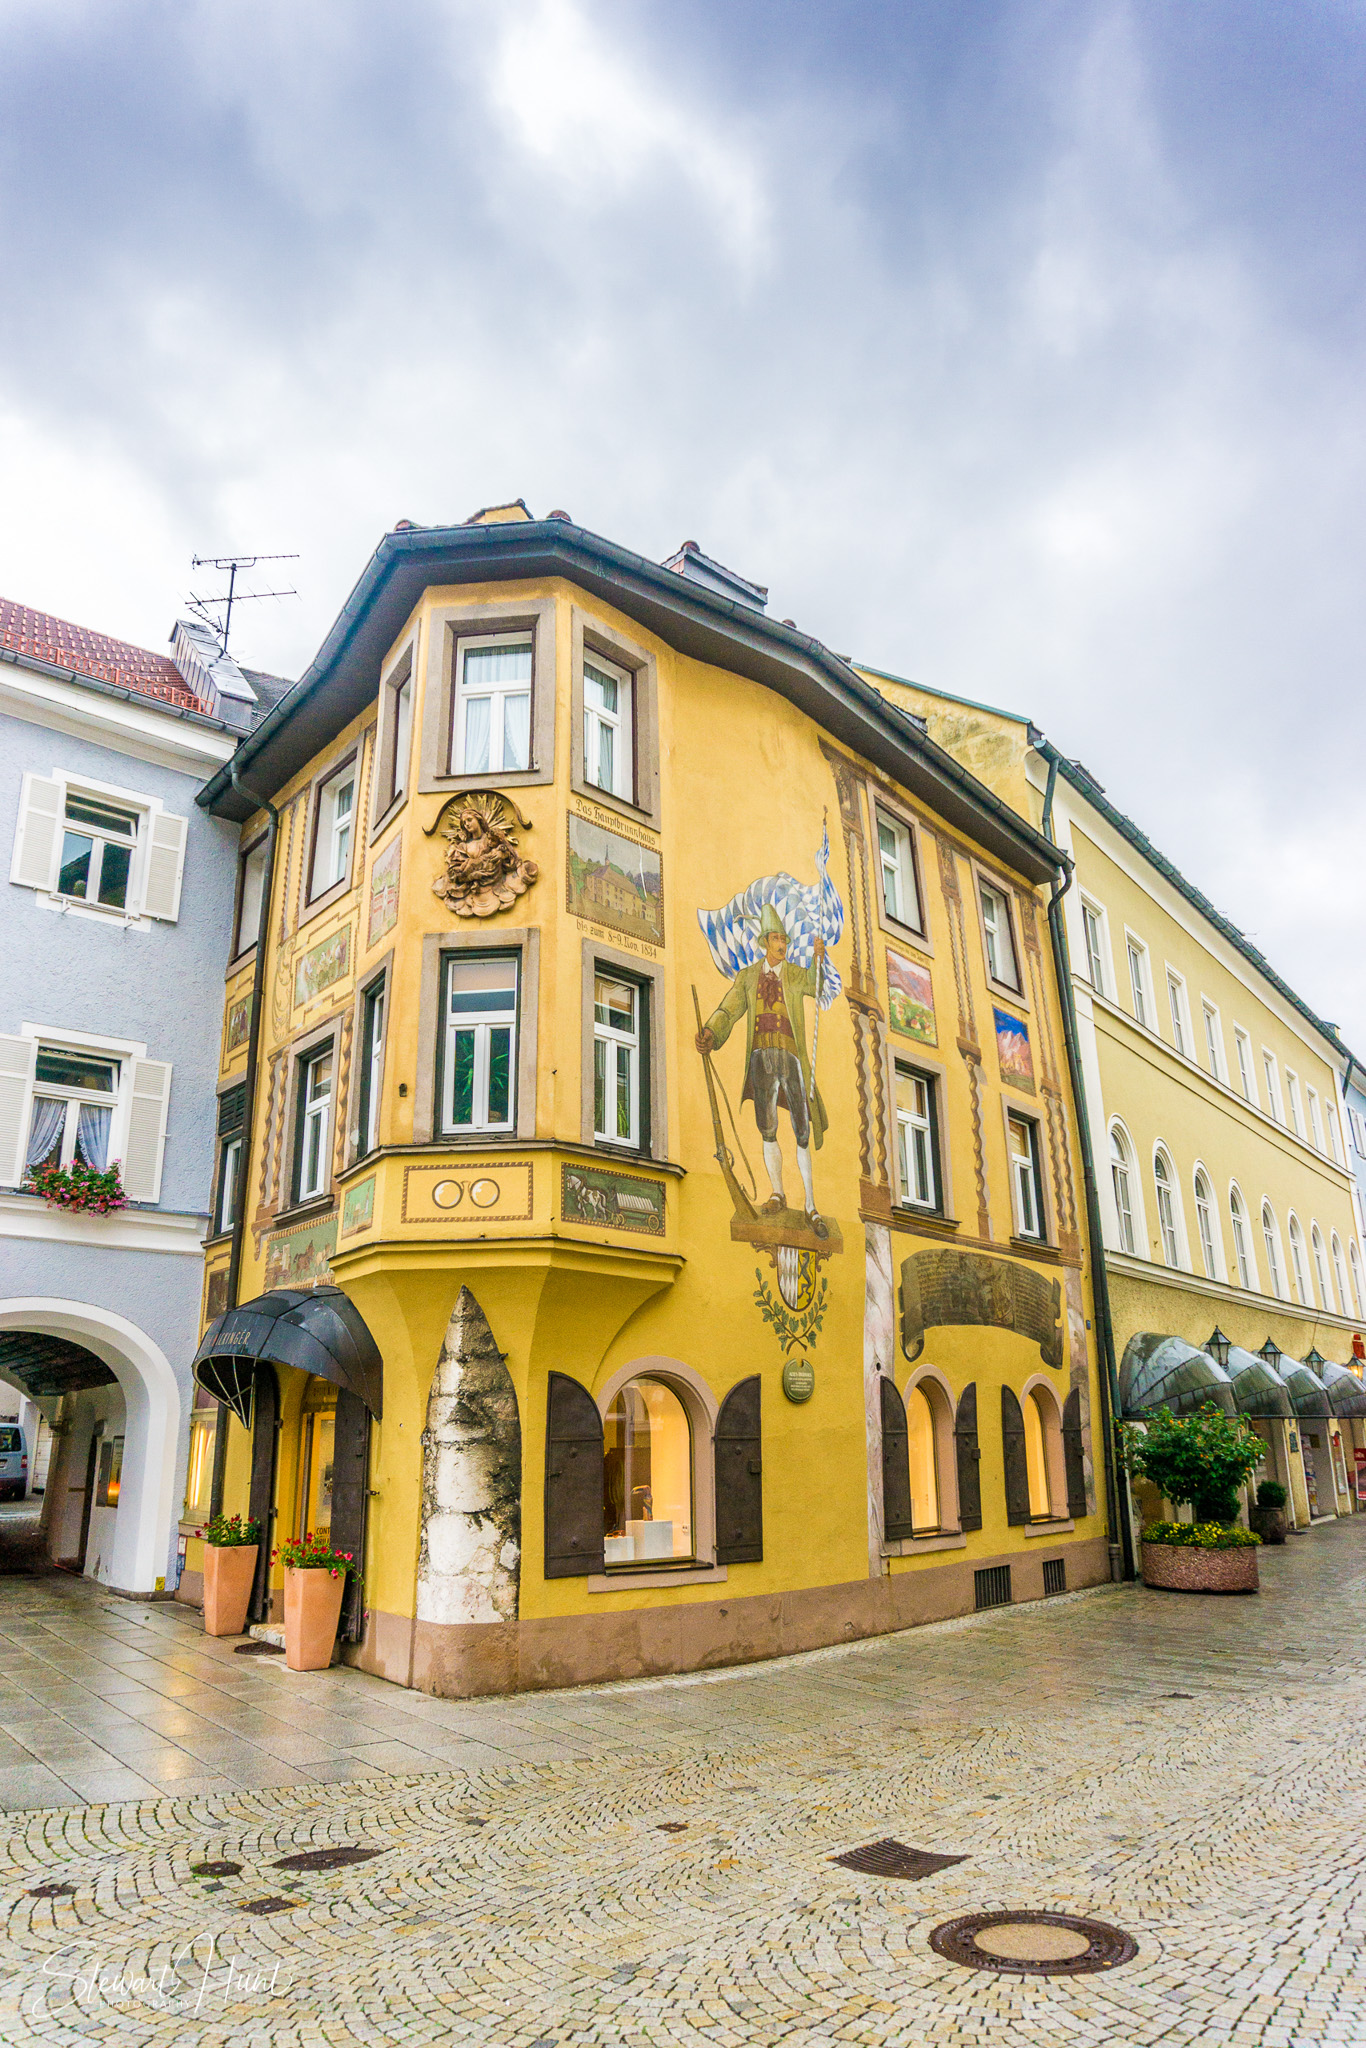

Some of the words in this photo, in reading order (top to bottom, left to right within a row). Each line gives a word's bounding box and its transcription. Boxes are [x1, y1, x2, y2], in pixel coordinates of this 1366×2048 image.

[576, 799, 592, 816] Das
[576, 919, 588, 932] bis
[590, 927, 604, 939] zum
[641, 943, 657, 958] 1834
